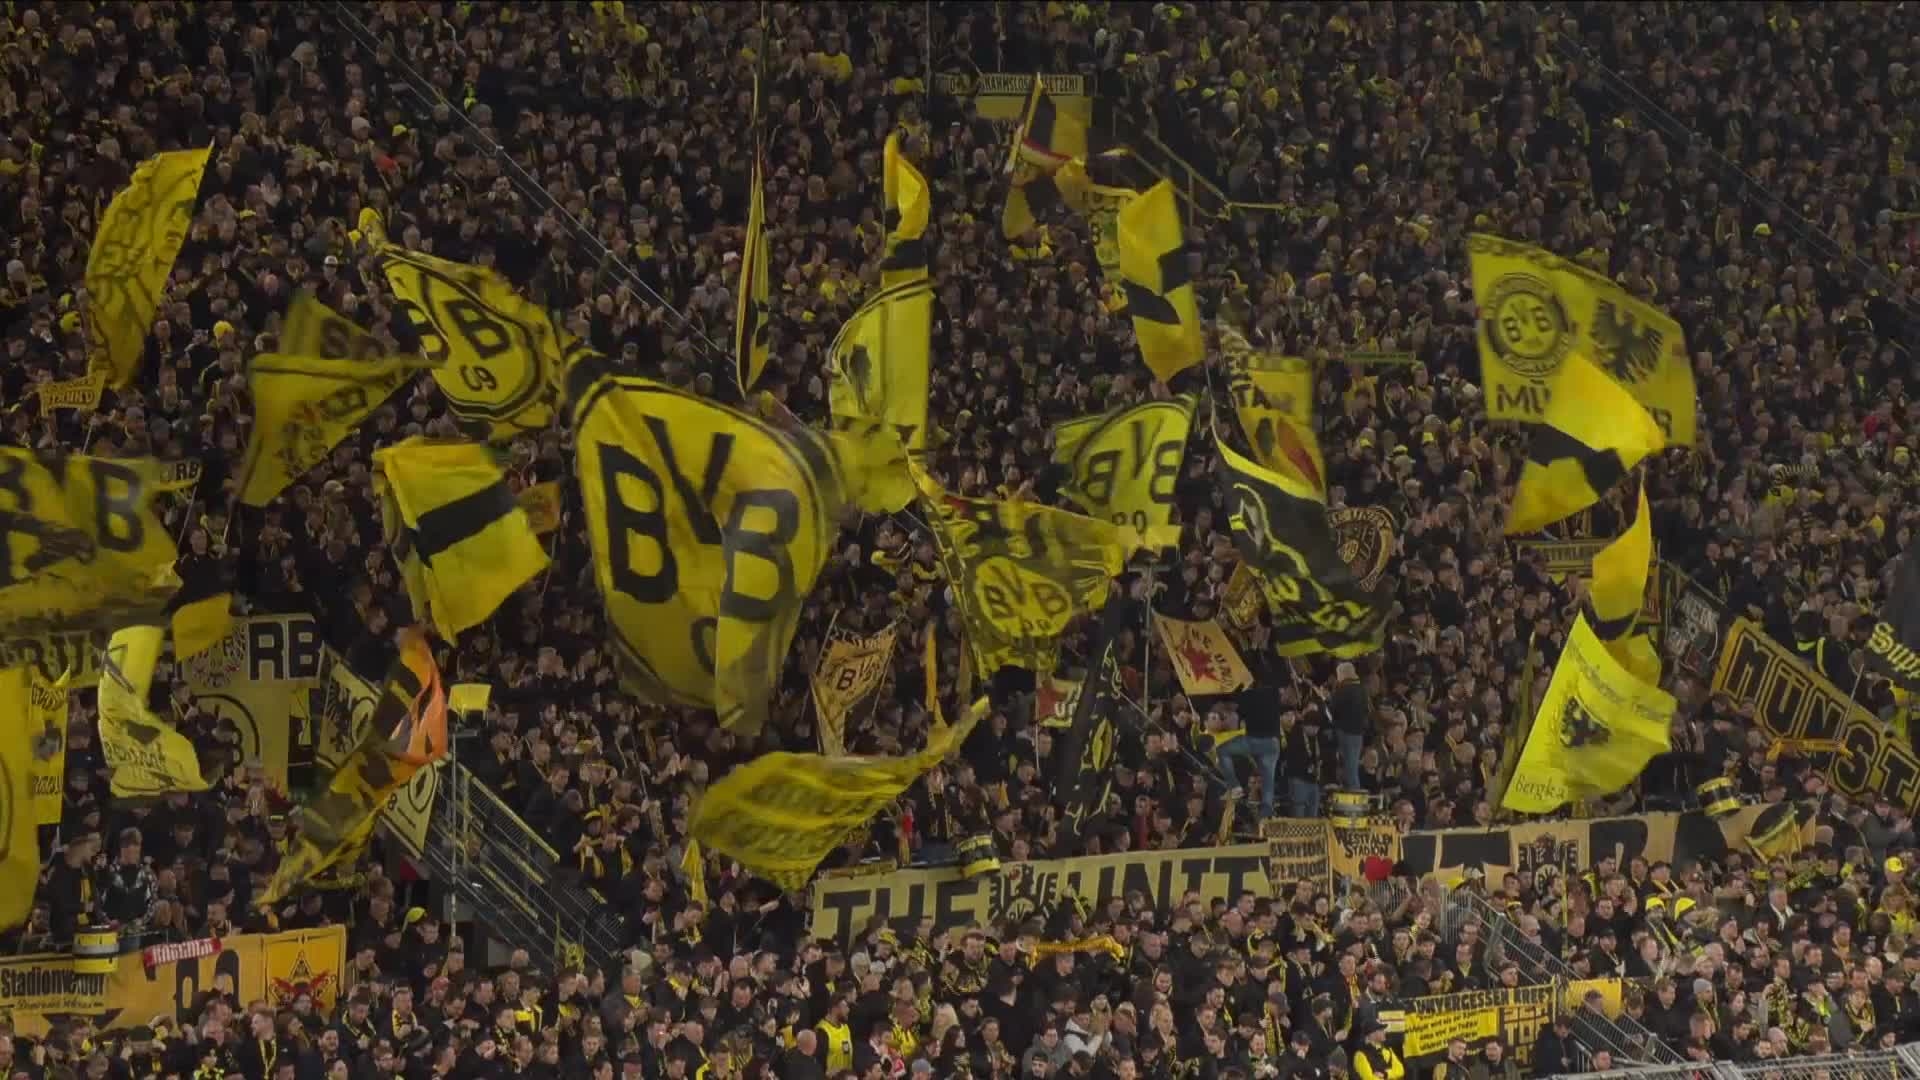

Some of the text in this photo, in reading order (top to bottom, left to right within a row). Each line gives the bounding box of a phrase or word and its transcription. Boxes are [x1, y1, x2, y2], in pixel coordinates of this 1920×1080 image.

[597, 414, 800, 622] BVB
[983, 562, 1069, 620] BVB
[823, 880, 990, 952] THE
